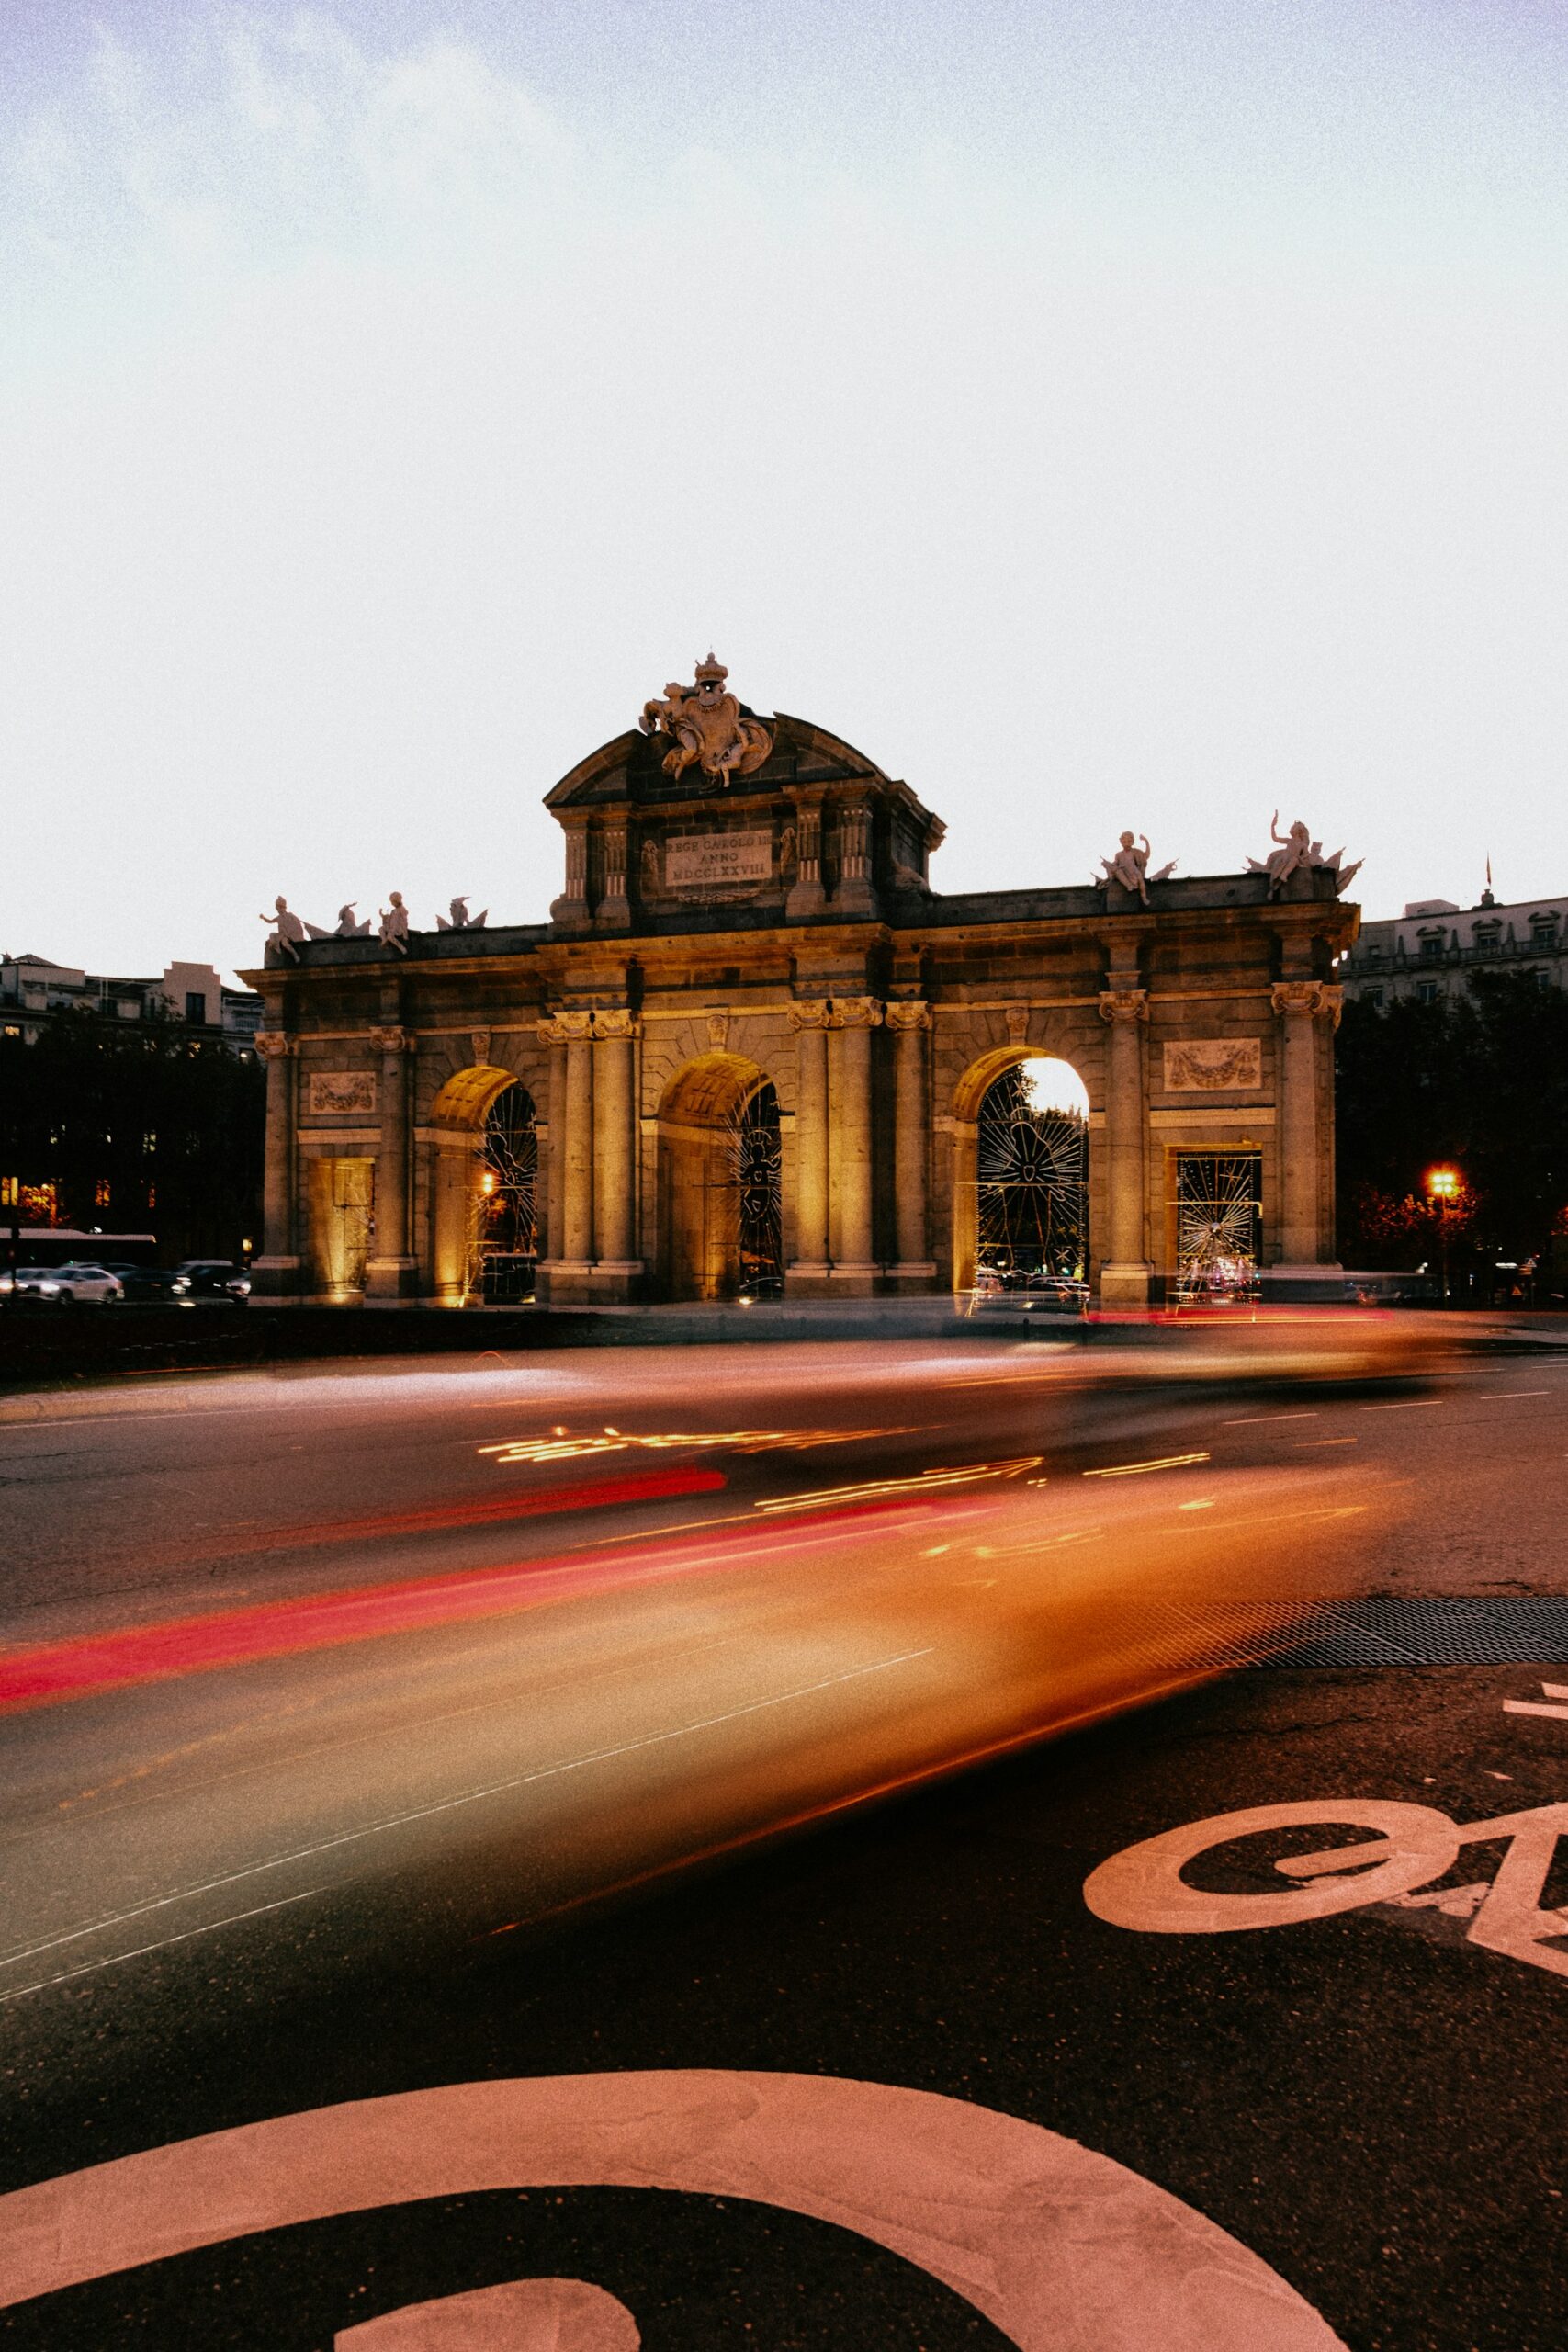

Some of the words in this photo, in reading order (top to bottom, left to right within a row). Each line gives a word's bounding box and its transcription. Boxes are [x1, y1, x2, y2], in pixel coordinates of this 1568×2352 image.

[665, 842, 698, 854] REGE
[701, 853, 739, 864] ANNO
[673, 864, 765, 880] MDCCLXXVIII
